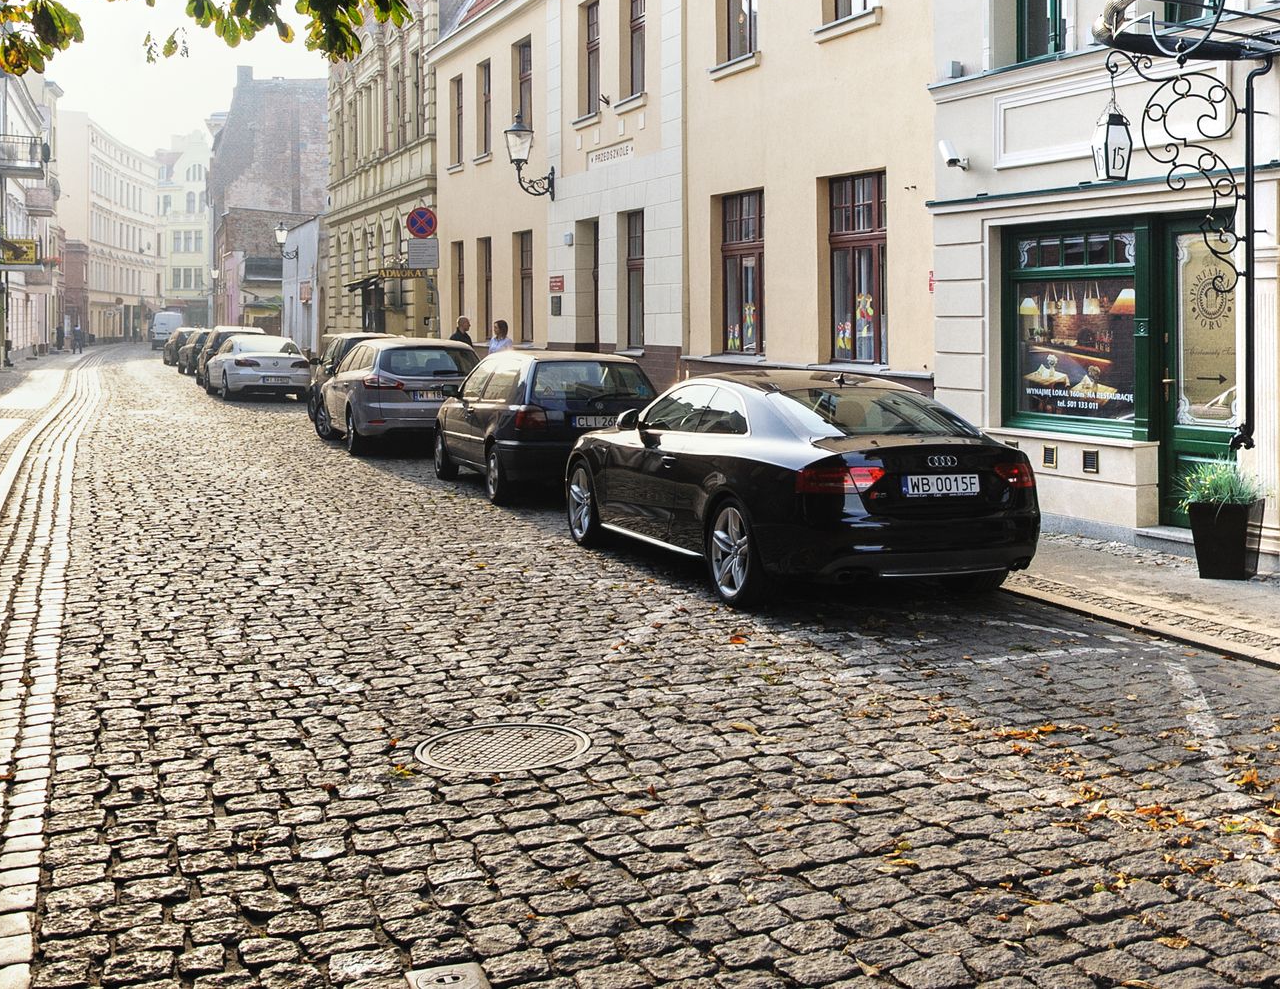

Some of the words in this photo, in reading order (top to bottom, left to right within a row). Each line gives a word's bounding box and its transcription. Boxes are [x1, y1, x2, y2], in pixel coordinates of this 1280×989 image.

[1112, 146, 1125, 170] 15
[379, 269, 424, 278] ADWOKA
[1026, 387, 1052, 397] WYNAJMĘ
[1052, 389, 1069, 397] LOKAL
[1086, 391, 1096, 399] NA
[1096, 392, 1134, 403] RESTAURACJĘ
[1067, 400, 1076, 408] 501
[1078, 401, 1088, 409] 133
[910, 477, 931, 493] WB
[936, 476, 977, 492] 0015F
